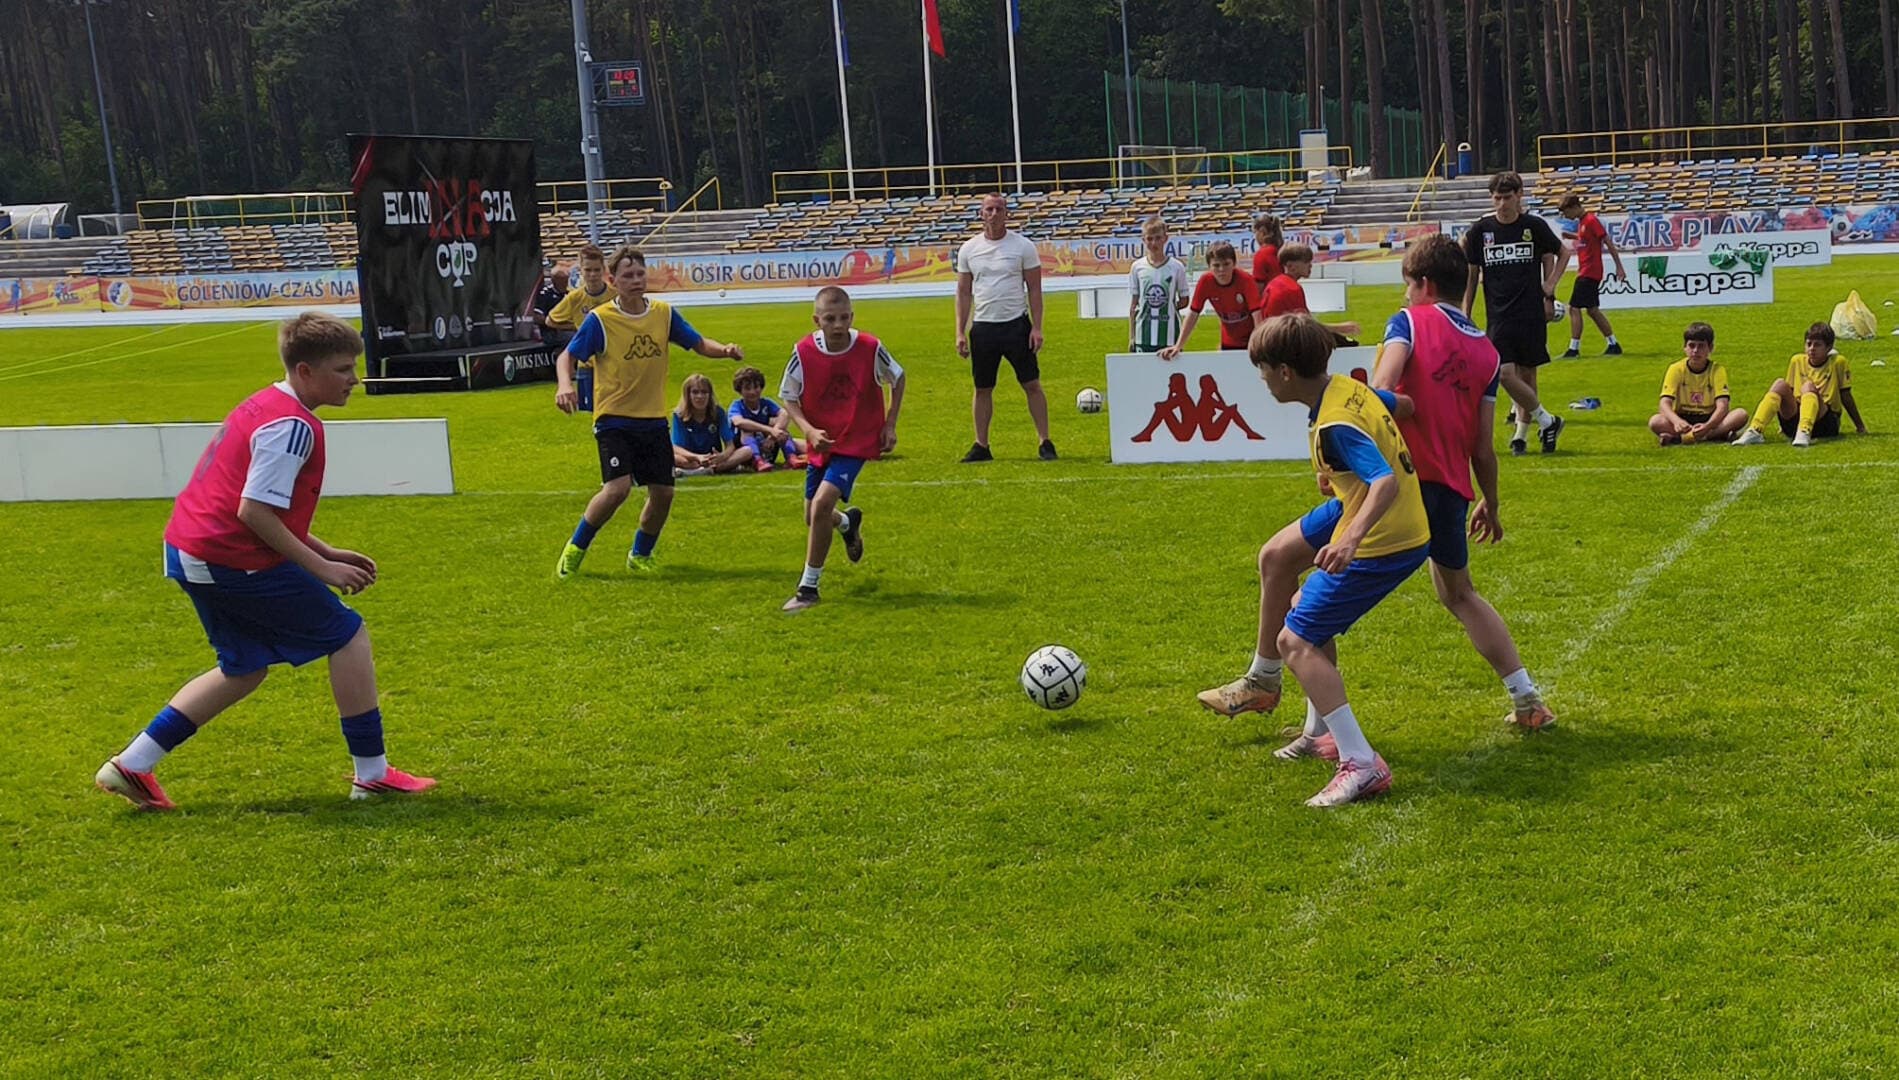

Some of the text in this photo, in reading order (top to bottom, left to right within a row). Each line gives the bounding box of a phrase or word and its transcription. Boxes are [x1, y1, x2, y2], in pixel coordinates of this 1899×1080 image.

[1607, 219, 1672, 247] FAIR
[436, 240, 477, 287] CUP
[1094, 243, 1144, 260] CITIU
[692, 258, 843, 283] OSIR GOLENIÓW
[1639, 270, 1756, 296] Kappa
[330, 280, 356, 297] NA
[515, 354, 533, 370] MKS
